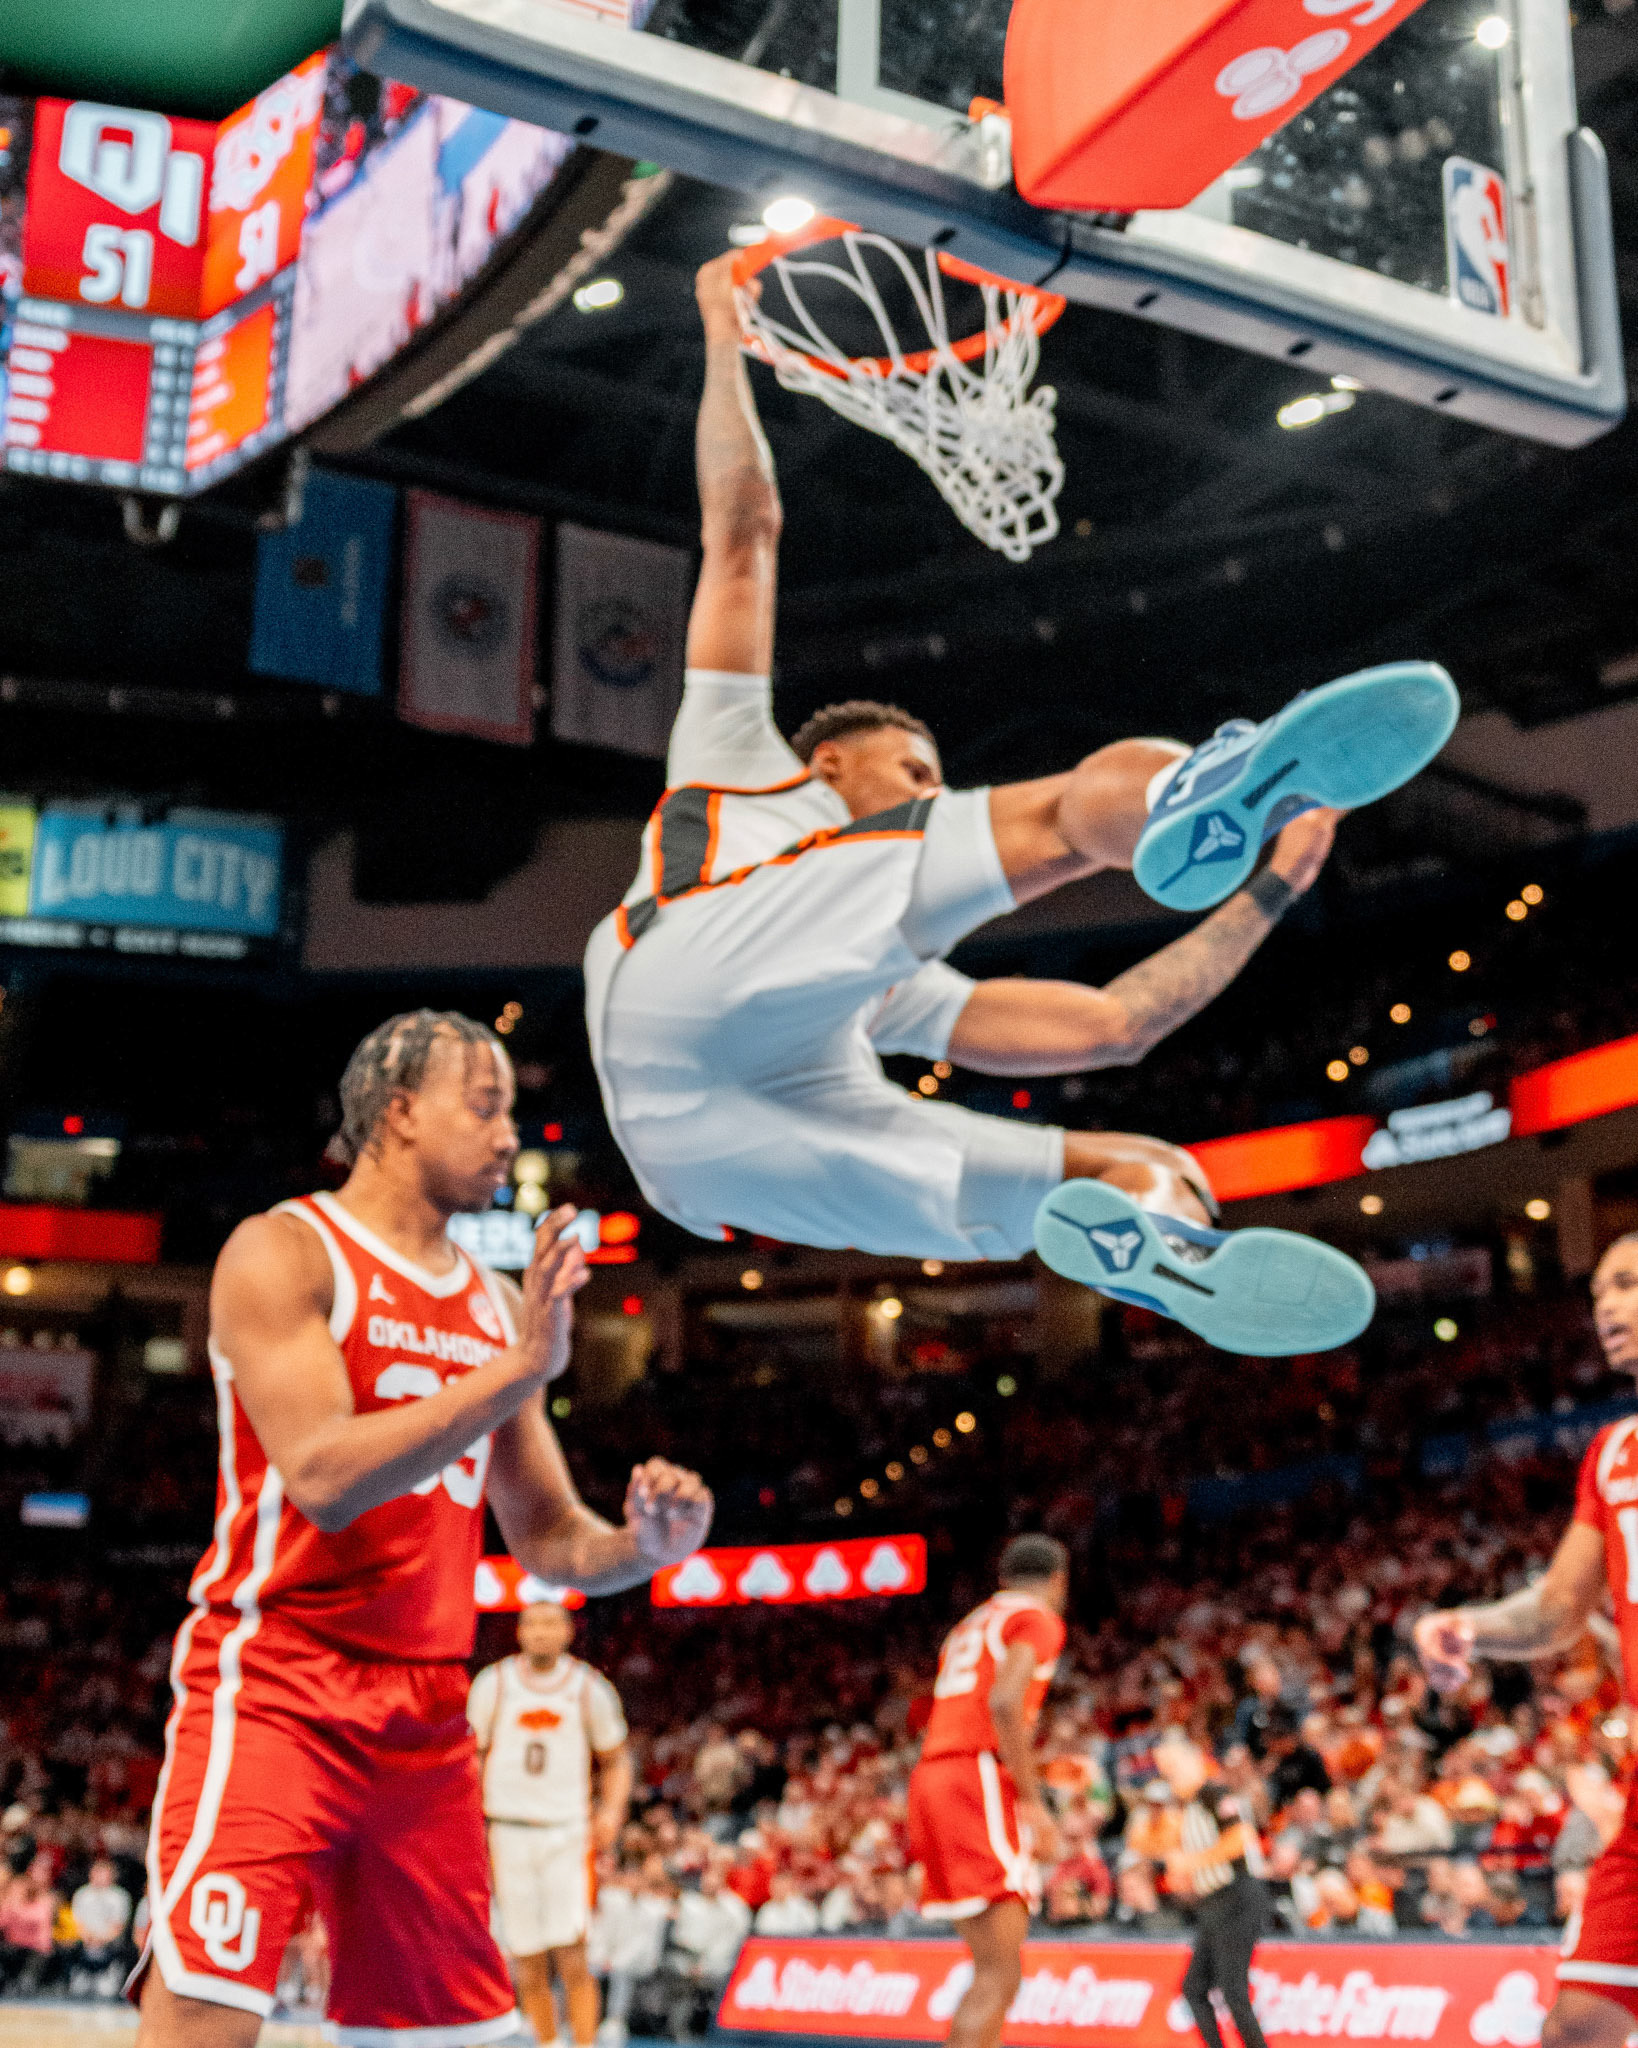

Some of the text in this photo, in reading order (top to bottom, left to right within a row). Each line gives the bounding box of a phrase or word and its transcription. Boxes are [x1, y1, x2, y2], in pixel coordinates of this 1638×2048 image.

[79, 223, 155, 309] 51
[41, 831, 280, 921] LOUD CITY
[368, 1315, 503, 1367] OKLAHOM
[525, 1741, 547, 1777] 0
[189, 1871, 262, 1972] OU
